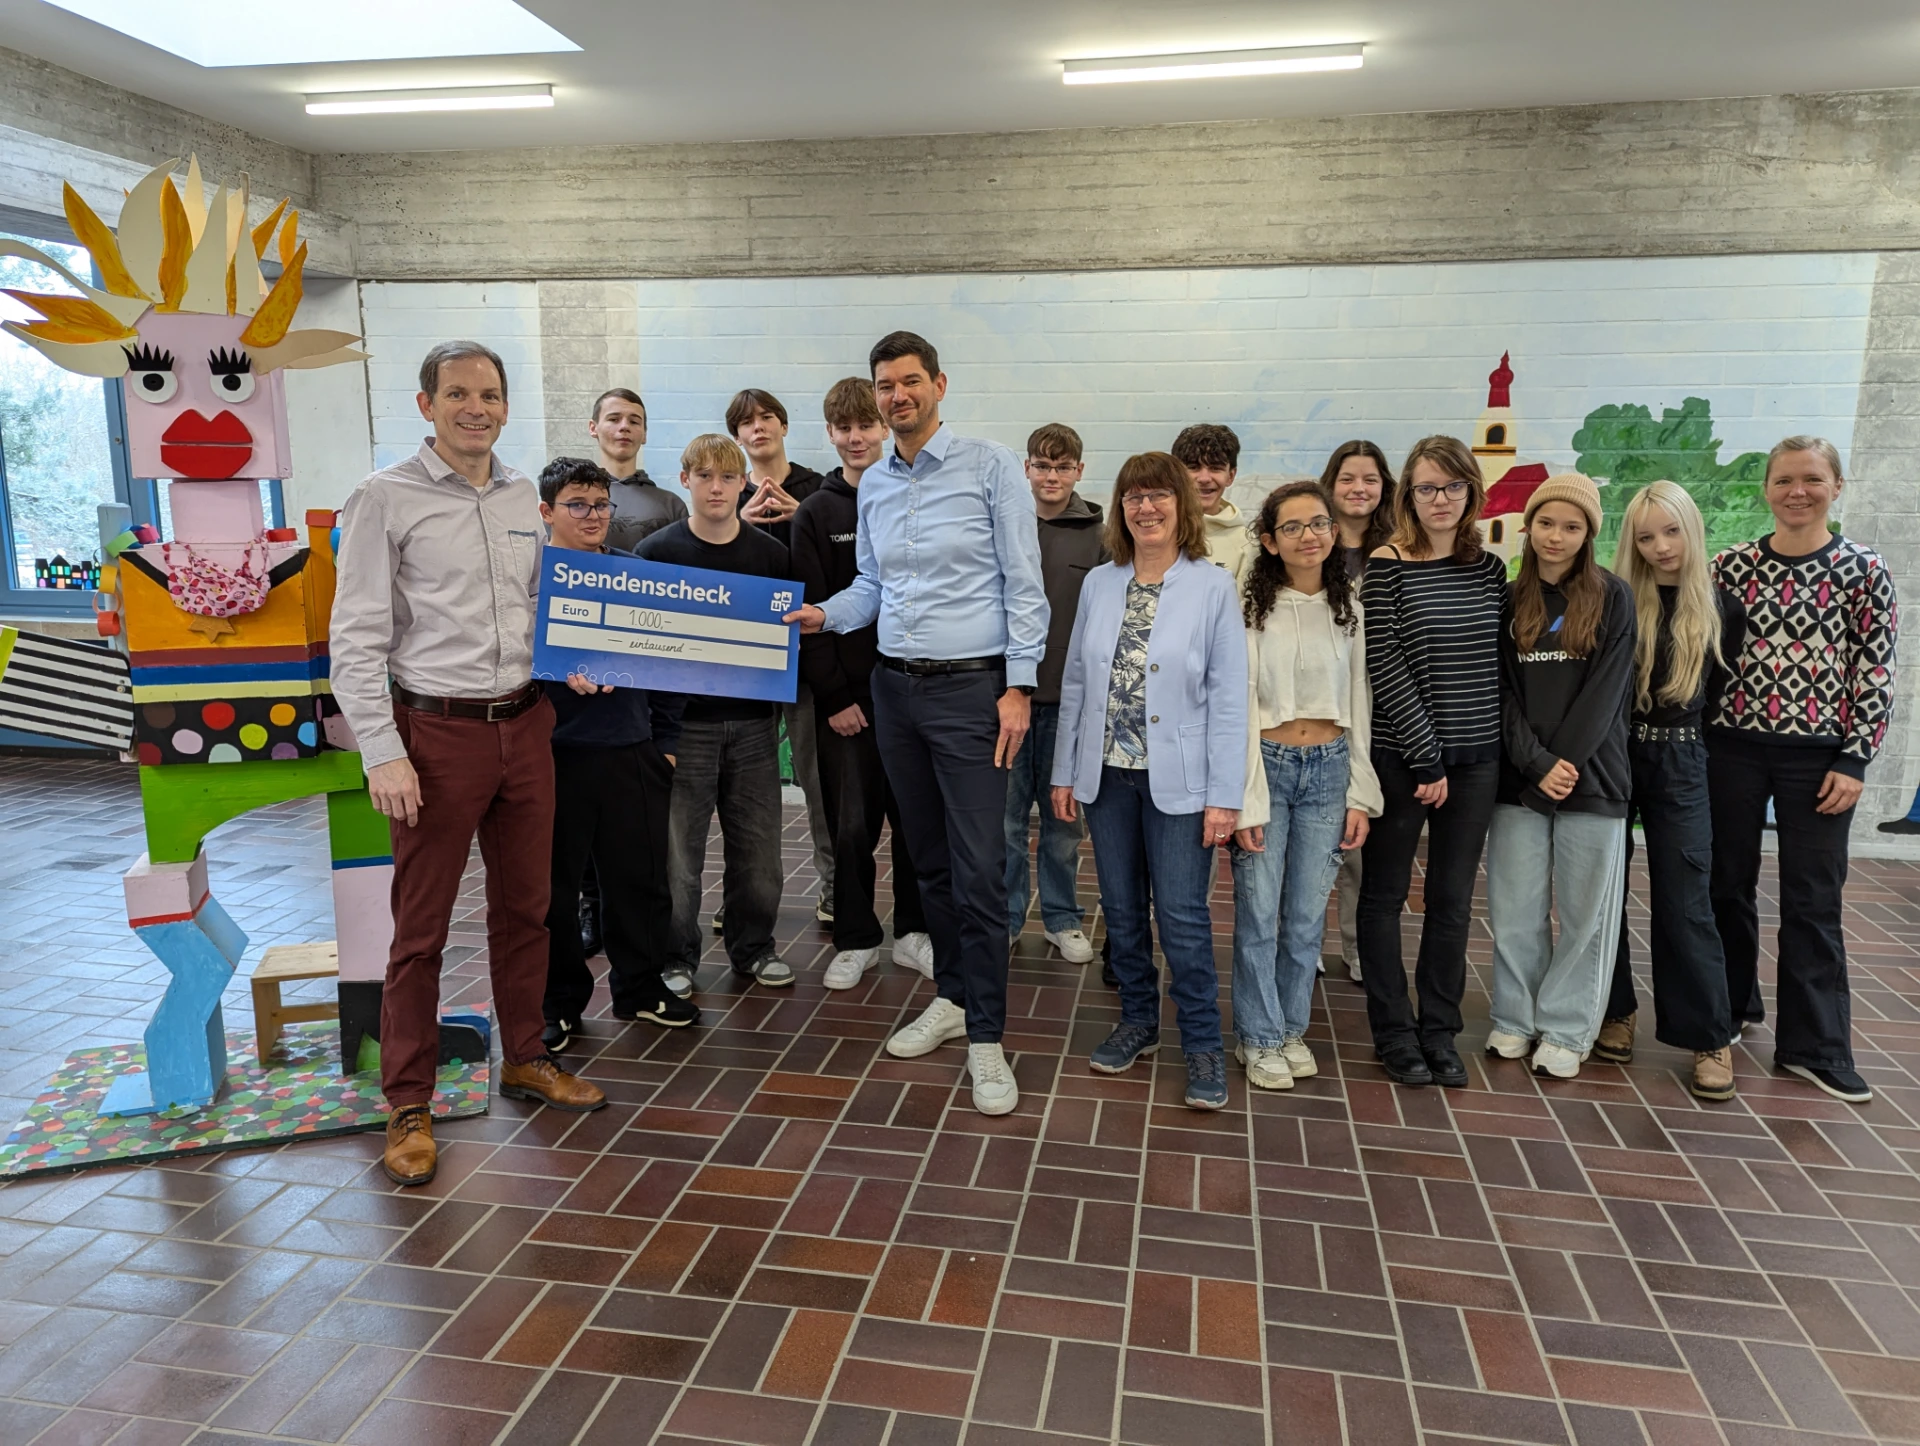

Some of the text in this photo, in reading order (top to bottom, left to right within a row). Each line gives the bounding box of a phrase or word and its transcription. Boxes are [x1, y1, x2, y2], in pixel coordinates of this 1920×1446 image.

[553, 562, 732, 606] Spendenscheck
[562, 604, 589, 617] Euro
[629, 638, 684, 653] eintausend
